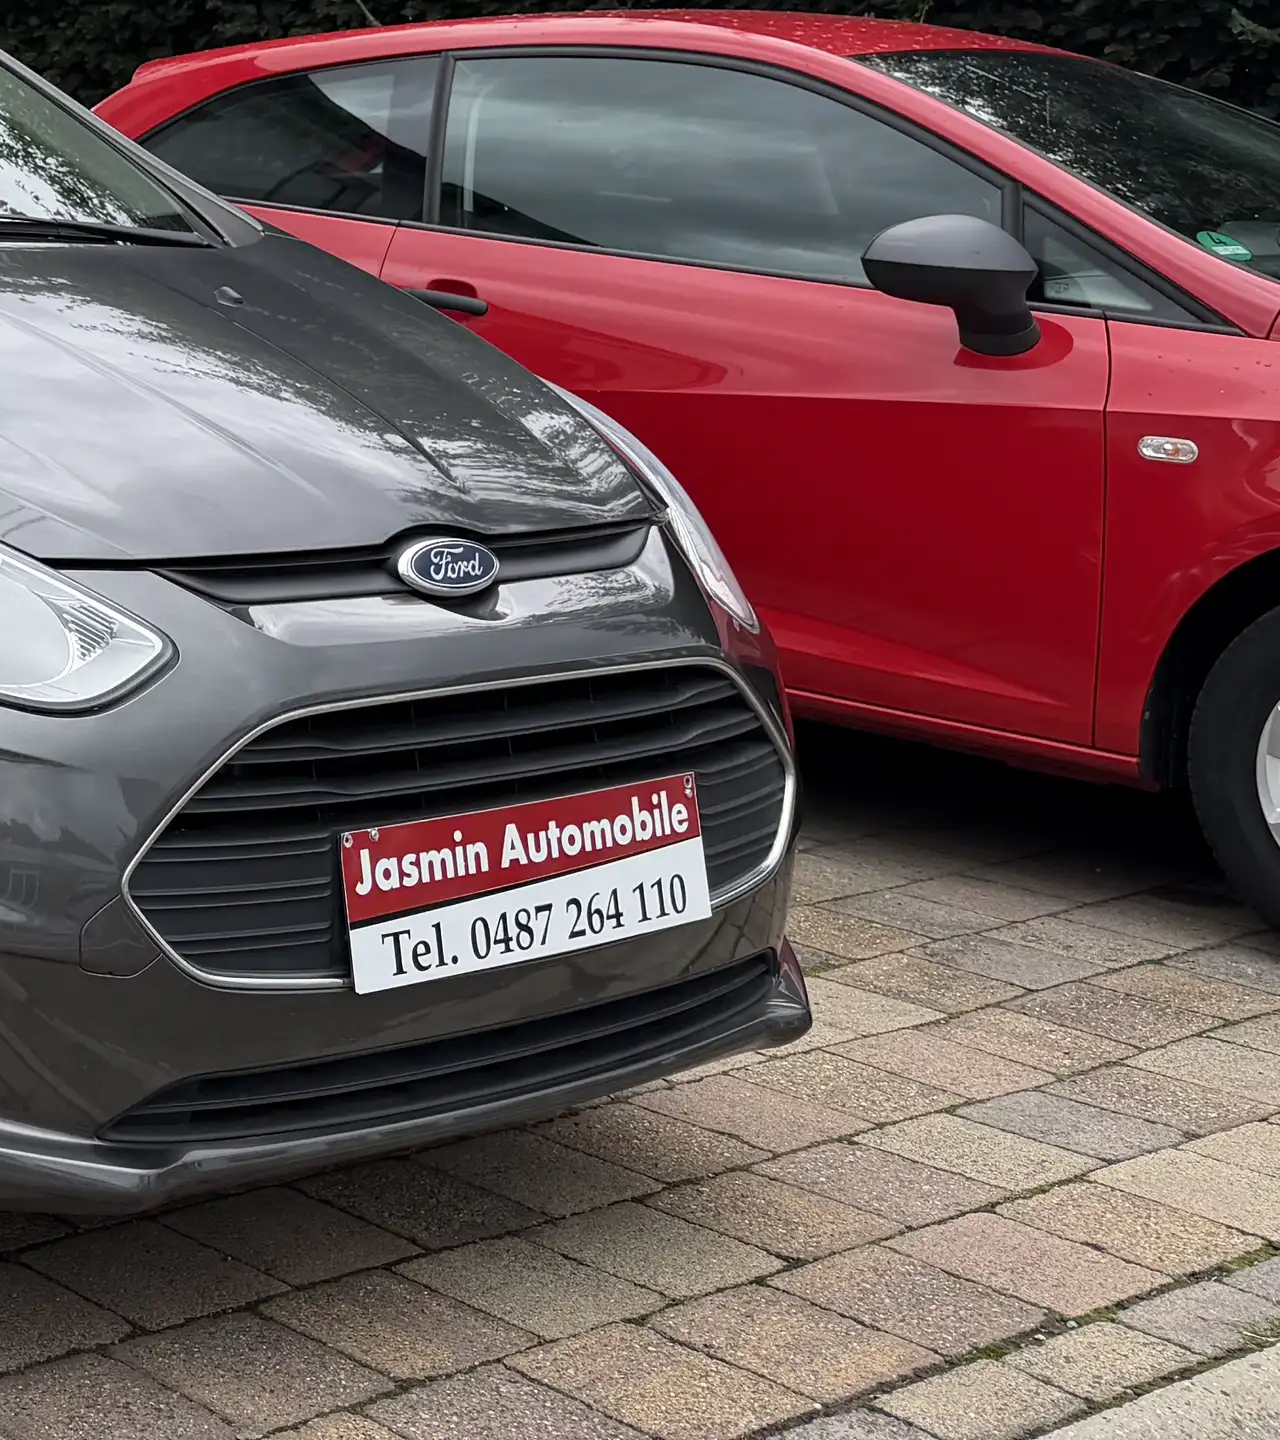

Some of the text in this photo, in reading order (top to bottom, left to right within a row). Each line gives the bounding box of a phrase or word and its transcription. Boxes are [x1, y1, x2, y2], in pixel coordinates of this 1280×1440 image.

[430, 547, 484, 581] Ford
[354, 790, 690, 897] Jasmin Automobile
[380, 872, 687, 977] Tel. 0487 264 110
